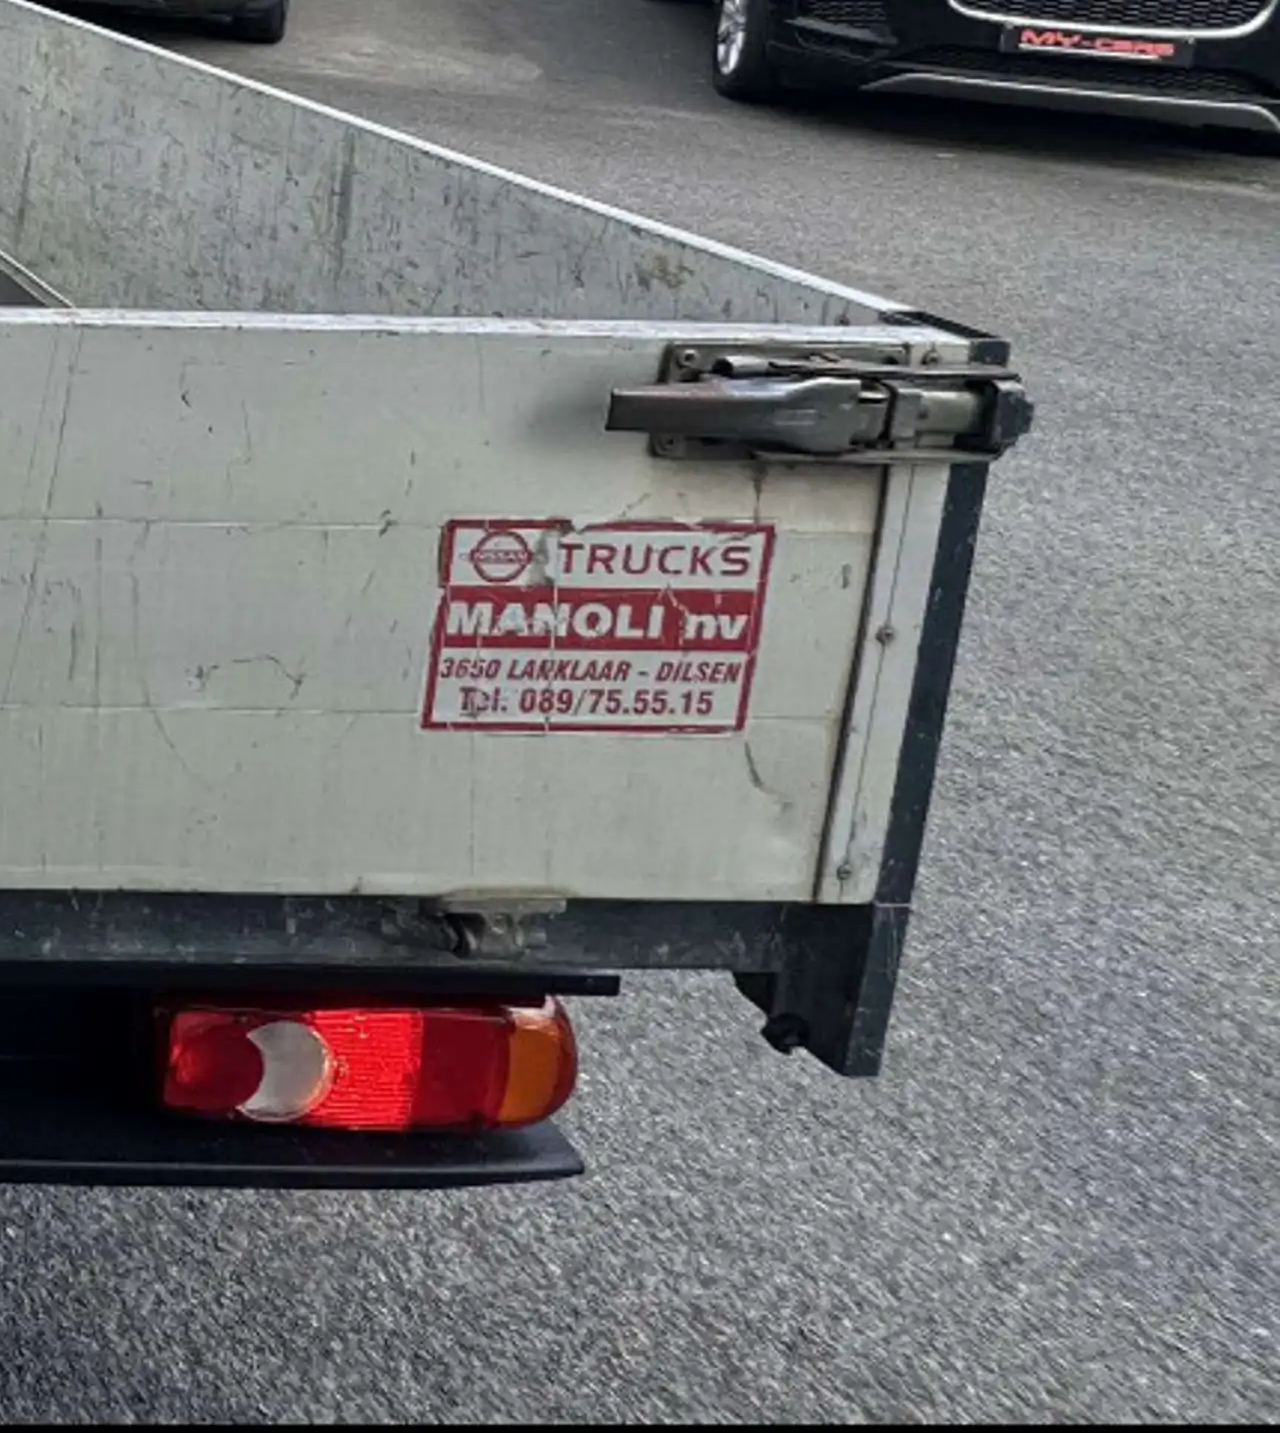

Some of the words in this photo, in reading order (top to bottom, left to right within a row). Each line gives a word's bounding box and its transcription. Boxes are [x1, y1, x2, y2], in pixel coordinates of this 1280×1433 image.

[560, 543, 752, 577] TRUCKS
[446, 602, 665, 639] MANOLI
[684, 613, 750, 640] nv
[440, 657, 502, 679] 3650
[506, 659, 632, 681] LANKLAAR
[655, 662, 741, 683] DILSEN
[519, 688, 713, 715] 089/75.55.15
